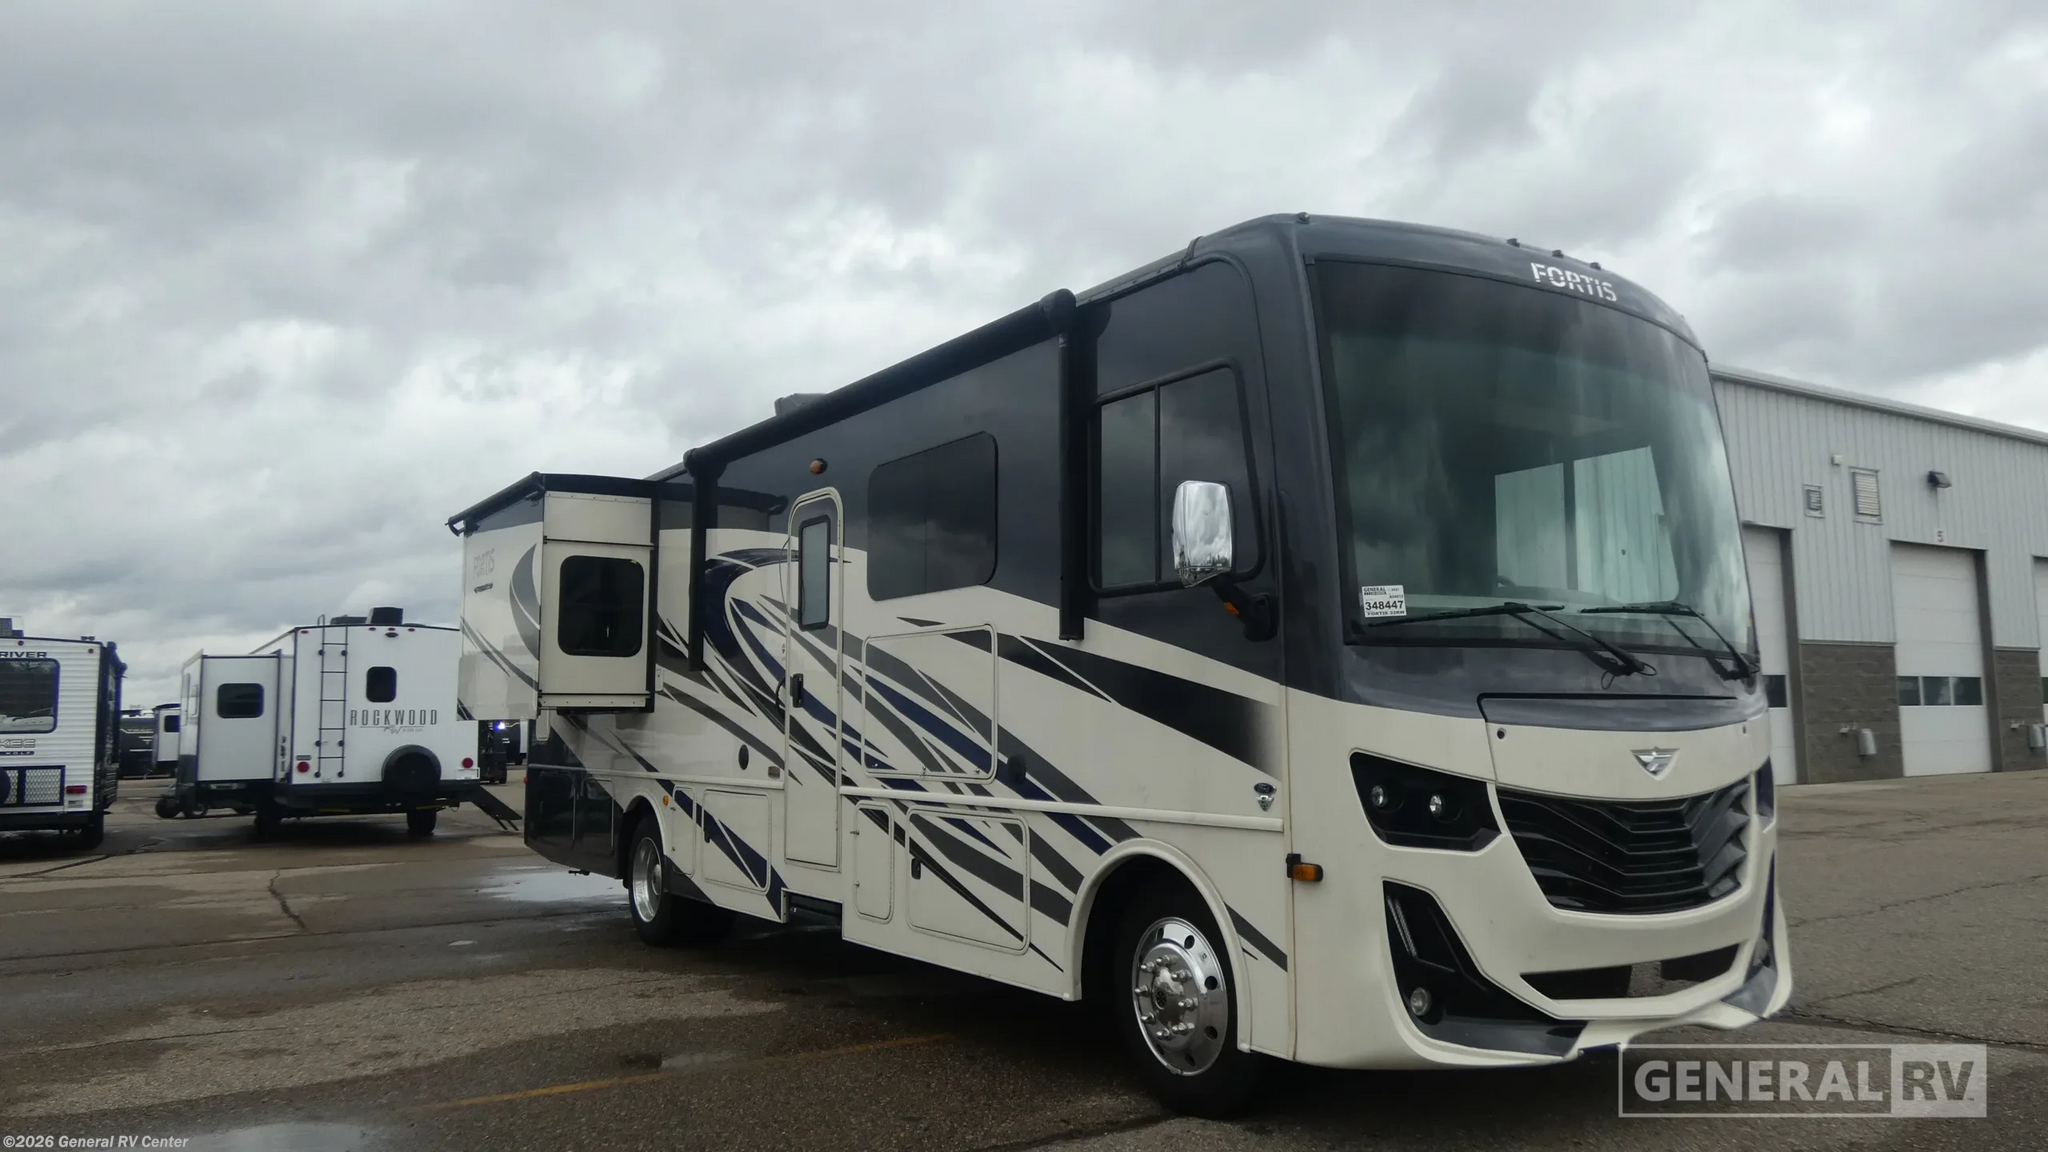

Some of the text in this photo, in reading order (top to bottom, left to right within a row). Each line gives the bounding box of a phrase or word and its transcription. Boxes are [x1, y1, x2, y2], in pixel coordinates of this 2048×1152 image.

[1530, 262, 1617, 301] FORTIS
[1936, 530, 1944, 543] 5
[1365, 600, 1404, 611] 348447
[349, 709, 438, 726] ROCKWOOD
